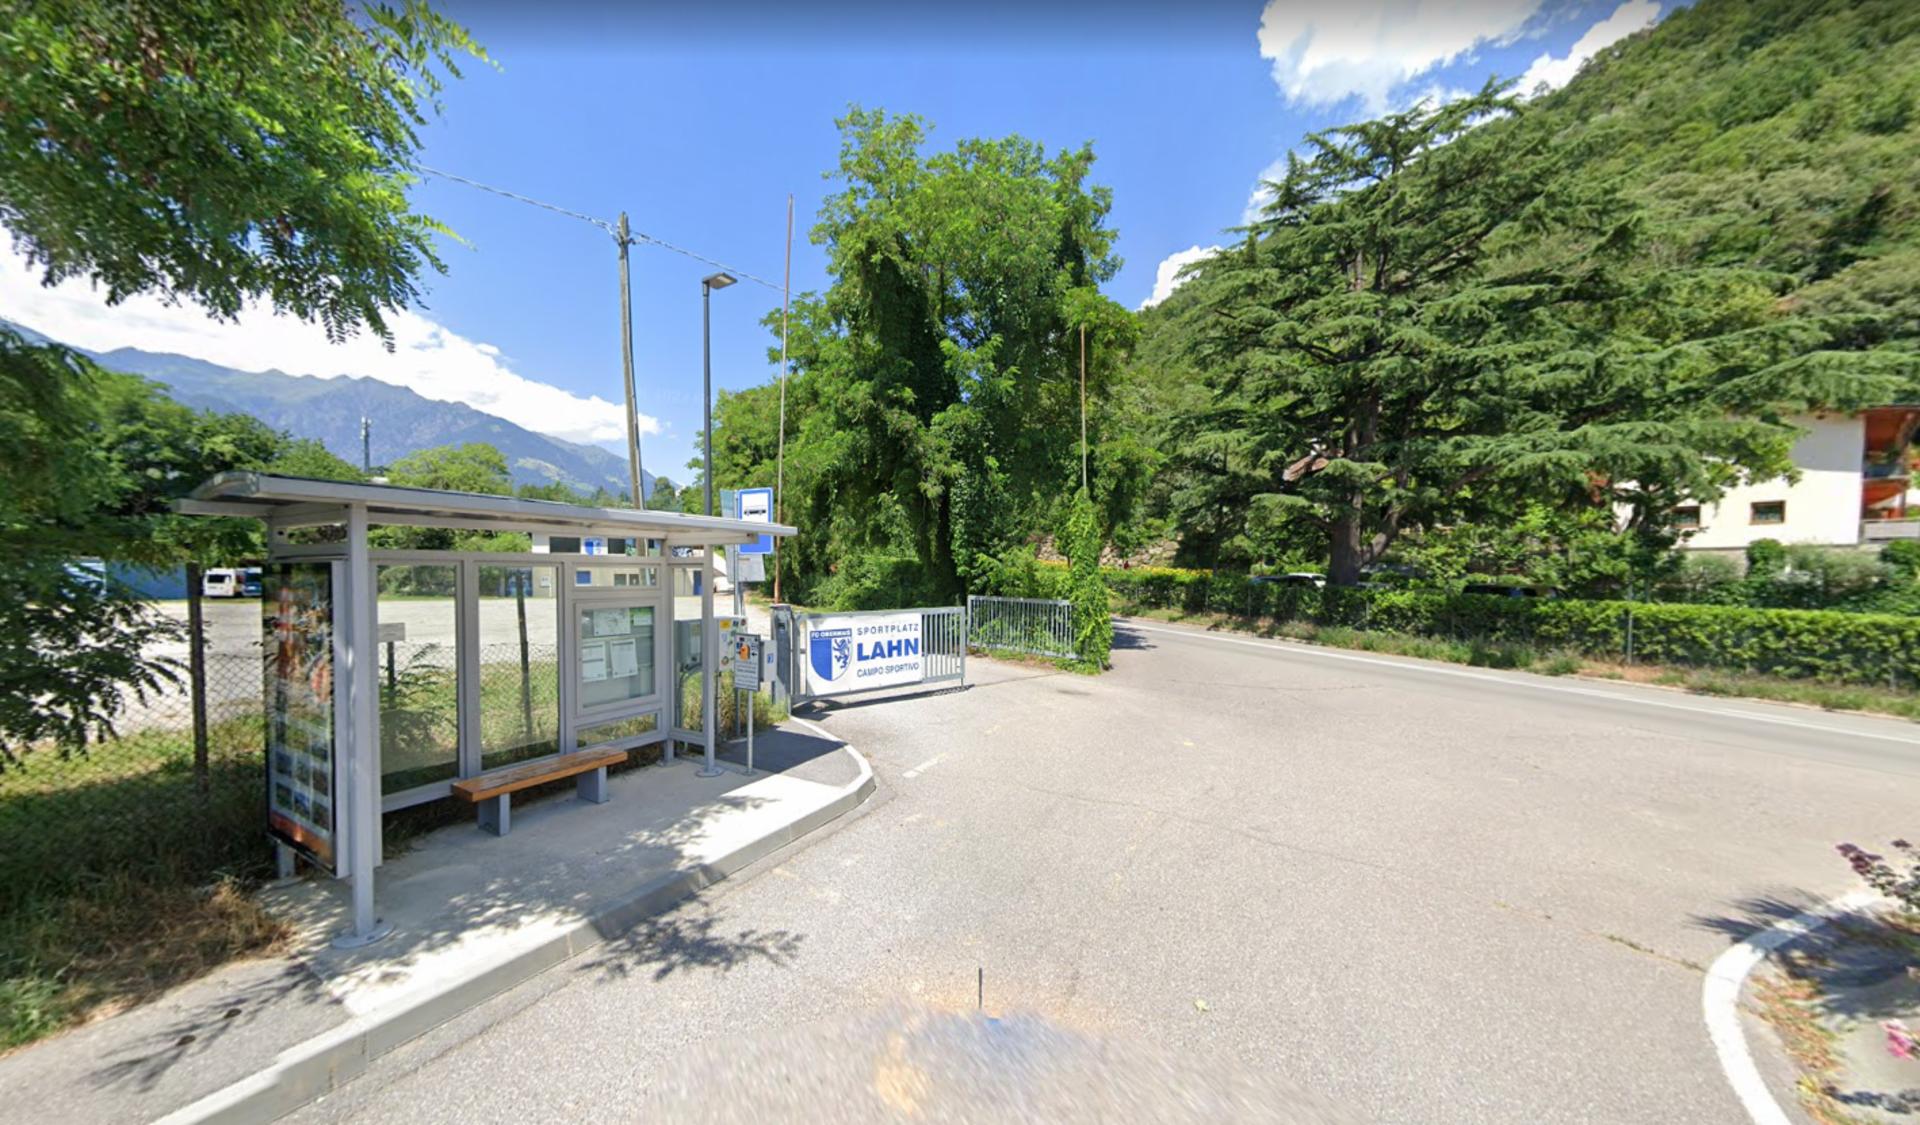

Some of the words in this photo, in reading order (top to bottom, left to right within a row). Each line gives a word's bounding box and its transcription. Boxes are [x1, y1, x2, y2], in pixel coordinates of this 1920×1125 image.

[857, 624, 918, 635] SPORTPLATZ
[857, 638, 918, 661] LAHN
[857, 667, 883, 677] CAMPO
[885, 662, 919, 674] SPORTIVO
